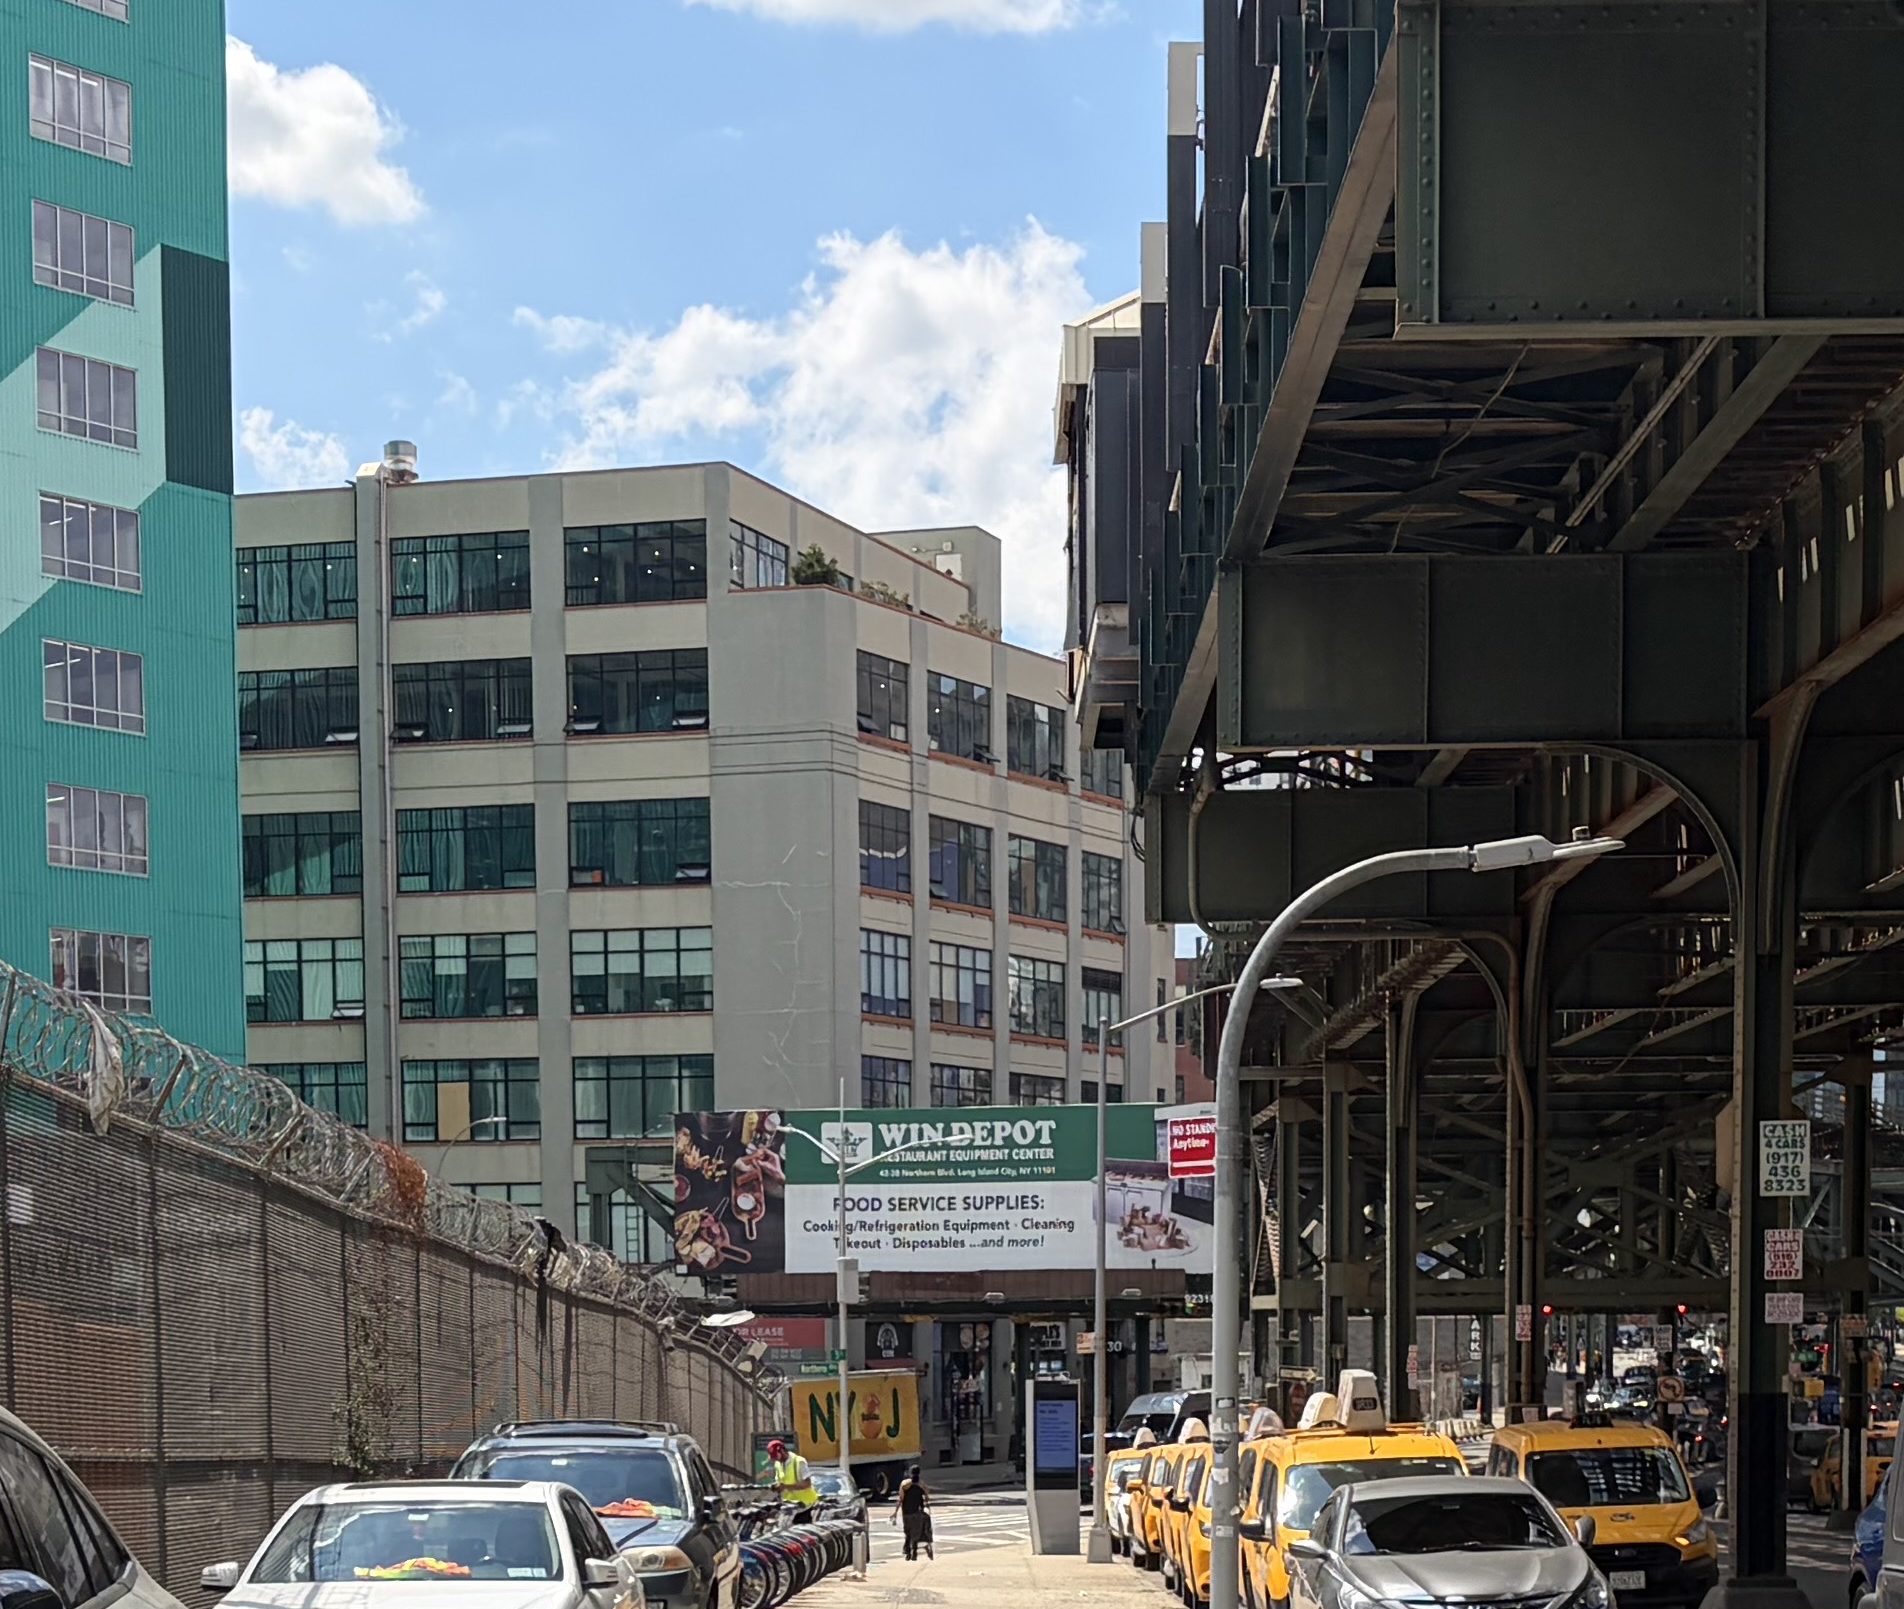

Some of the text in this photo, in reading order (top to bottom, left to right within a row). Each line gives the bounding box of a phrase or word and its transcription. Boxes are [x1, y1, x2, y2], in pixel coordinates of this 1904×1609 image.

[878, 1119, 1056, 1148] WIN DEPOT
[1764, 1124, 1807, 1138] CASH
[1765, 1138, 1806, 1149] 4 CARS
[949, 1148, 1010, 1161] EQUIPMENT
[1012, 1148, 1054, 1160] CENTER
[1766, 1151, 1804, 1164] (917)
[1768, 1165, 1801, 1178] 436
[1764, 1179, 1806, 1192] 8323
[887, 1195, 956, 1212] SERVICE
[963, 1194, 1045, 1211] SUPPLIES:
[803, 1217, 1075, 1236] Cookig/Refrigeration Equipment Cleaning
[833, 1238, 881, 1249] Tkeout
[892, 1237, 965, 1252] Disposables
[1007, 1235, 1045, 1248] more!
